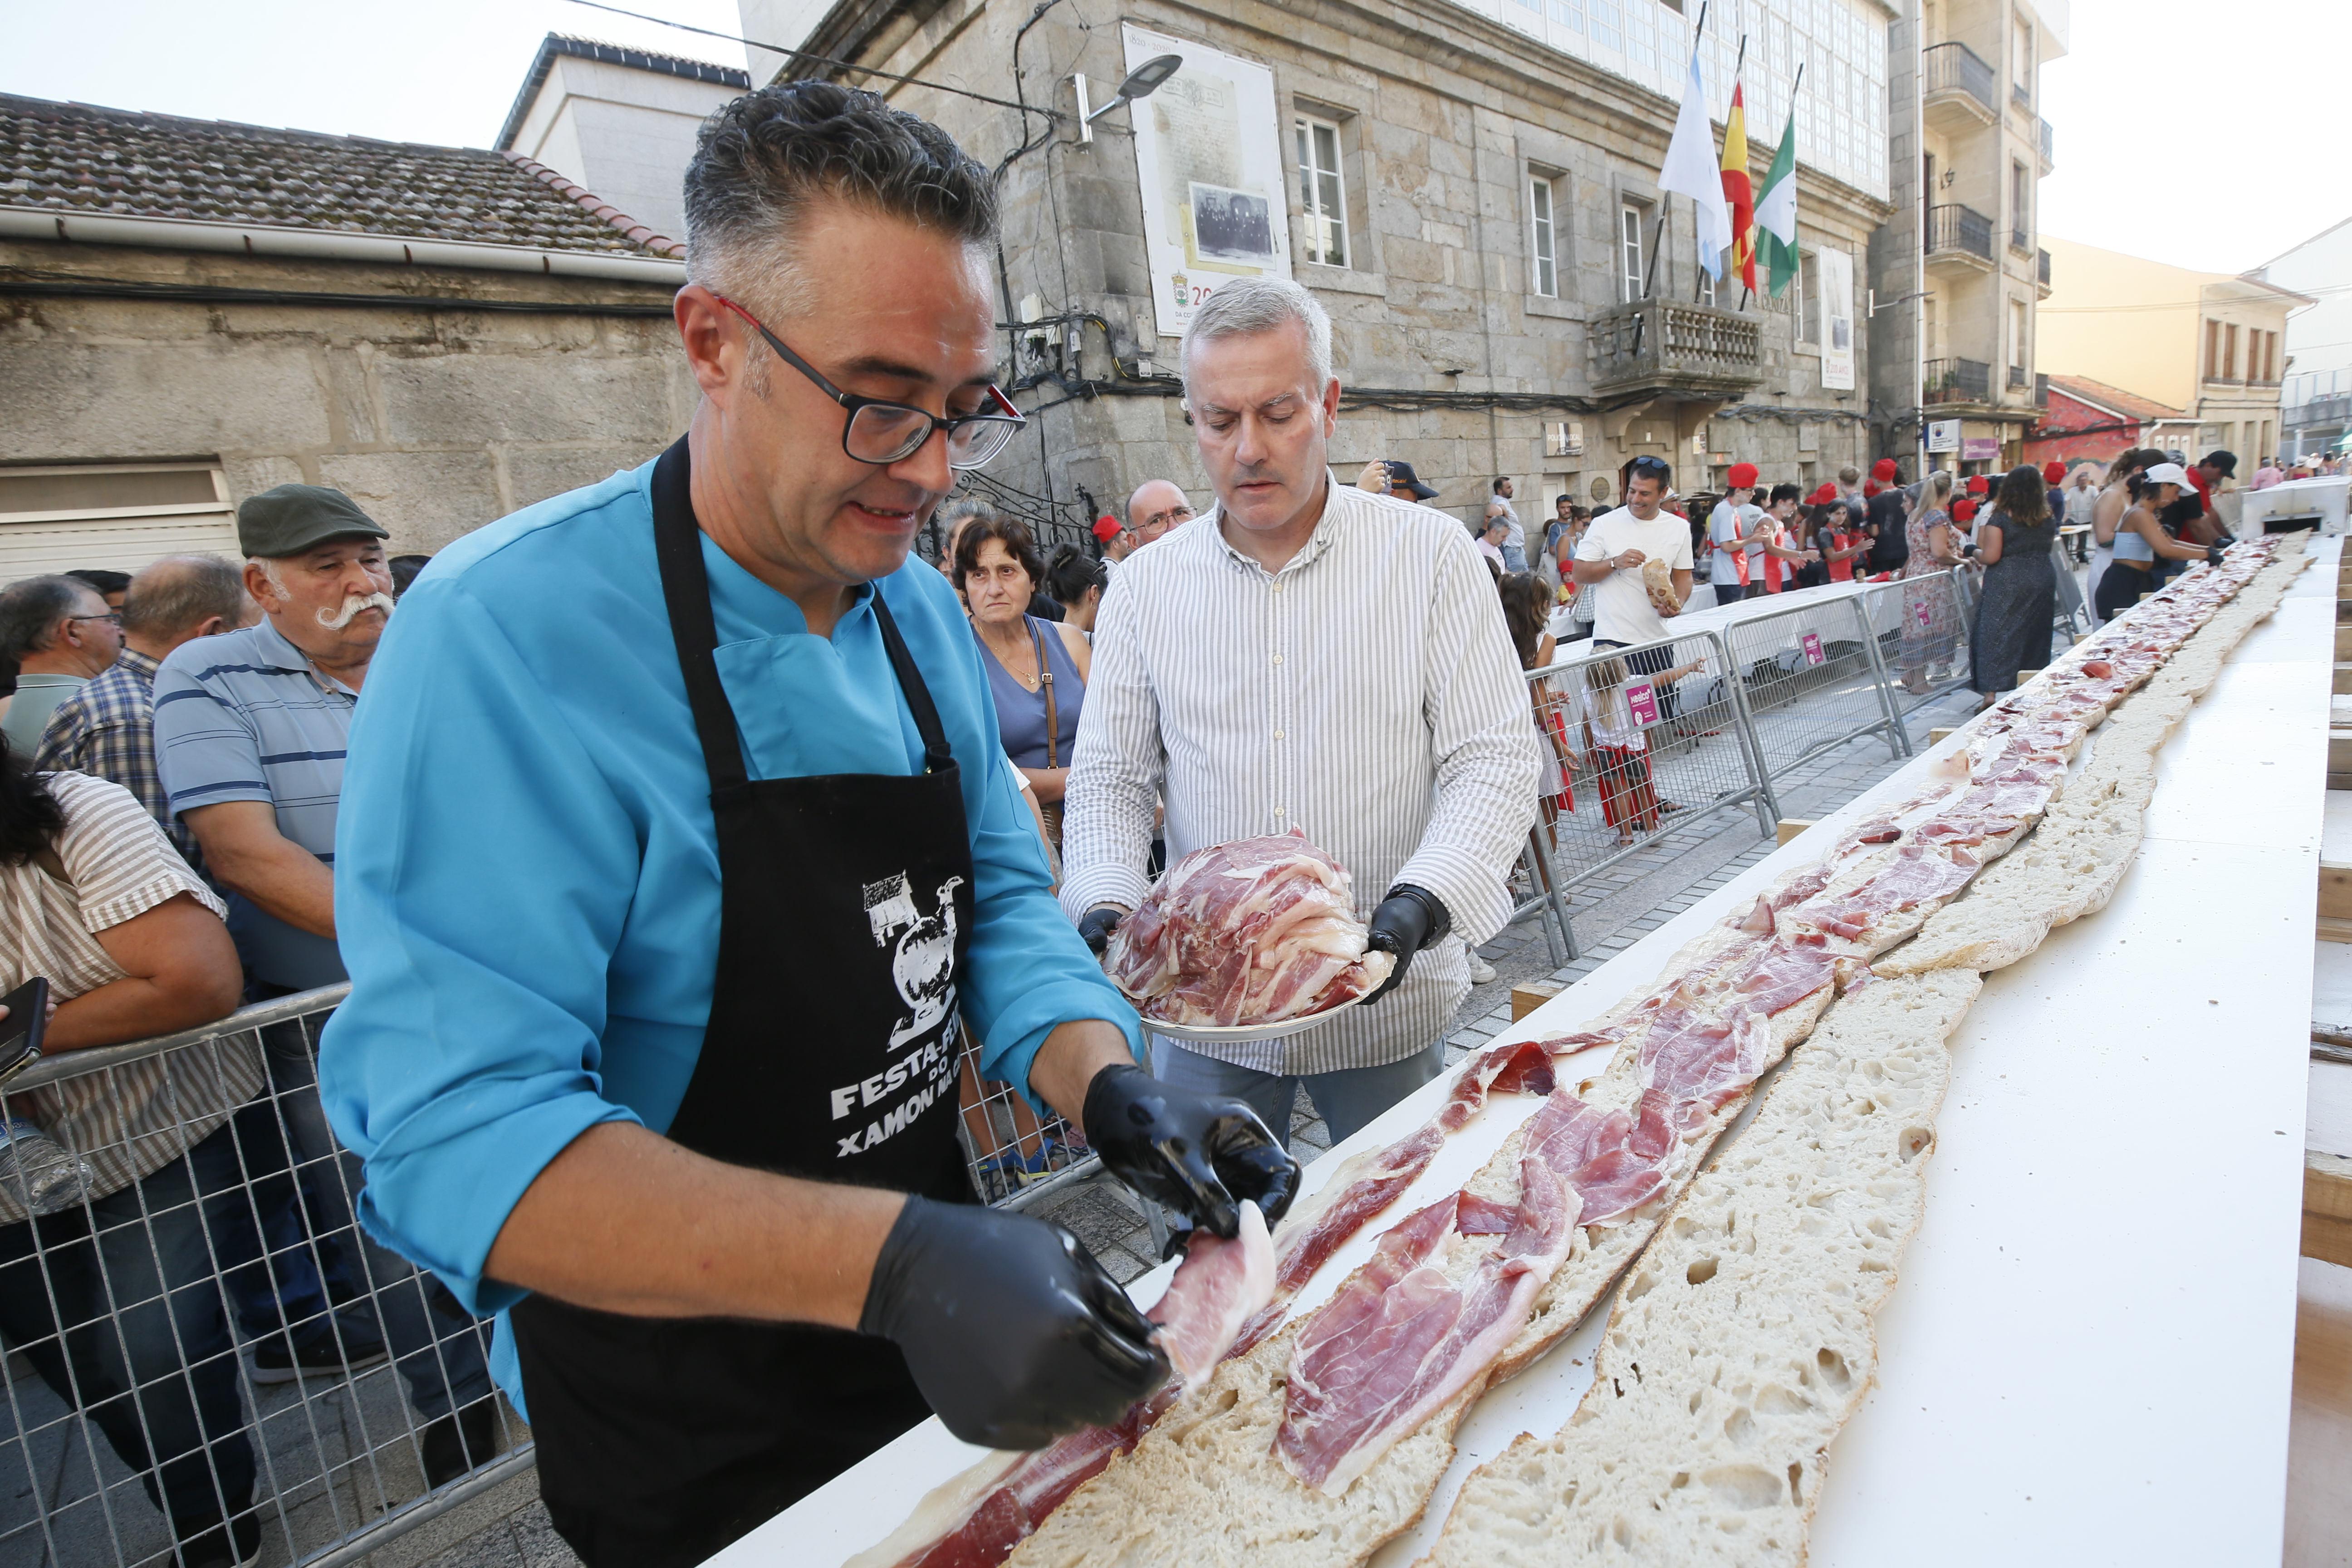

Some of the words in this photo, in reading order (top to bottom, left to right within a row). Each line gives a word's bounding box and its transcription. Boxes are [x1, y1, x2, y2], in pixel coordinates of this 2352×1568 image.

[1128, 34, 1146, 46] 1820
[1153, 43, 1171, 53] 2020
[929, 1056, 948, 1082] DO
[837, 1084, 934, 1158] XAMON
[938, 1069, 953, 1098] NA
